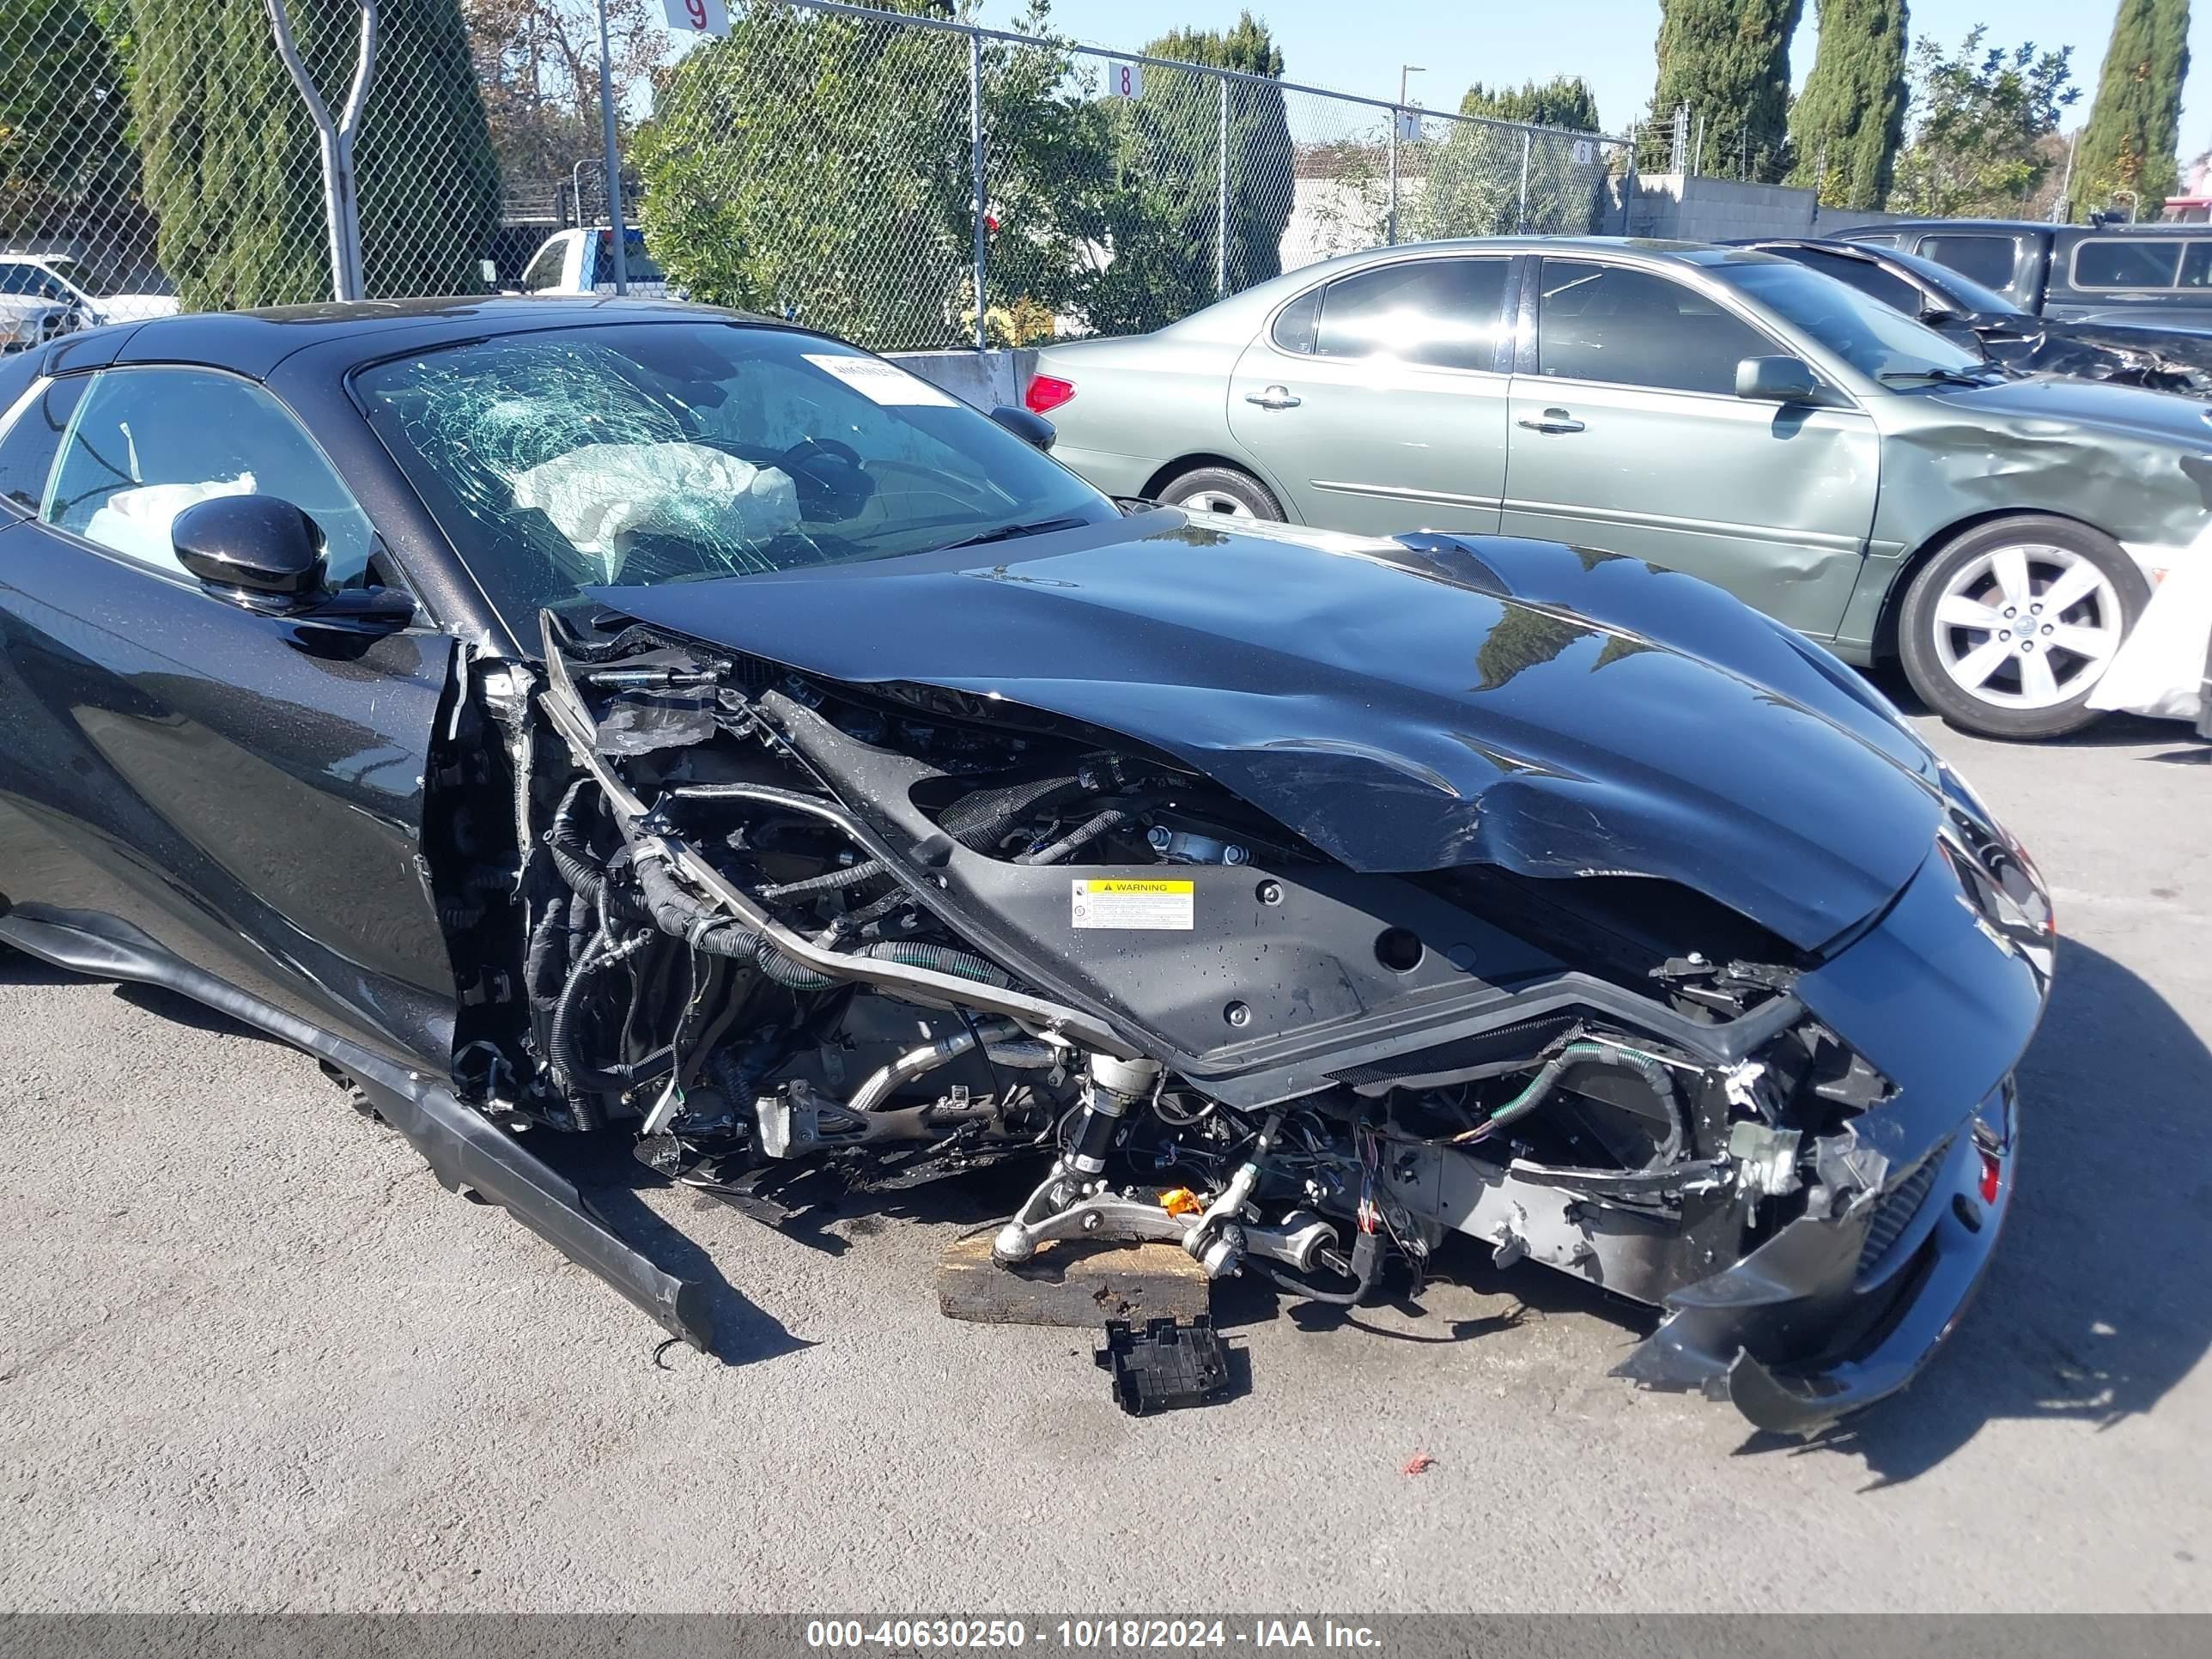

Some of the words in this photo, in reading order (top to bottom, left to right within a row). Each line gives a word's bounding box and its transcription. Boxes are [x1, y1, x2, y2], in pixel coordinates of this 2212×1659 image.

[685, 0, 708, 30] 9
[1121, 66, 1131, 96] 8
[1406, 115, 1413, 138] 7
[1580, 143, 1586, 162] 6
